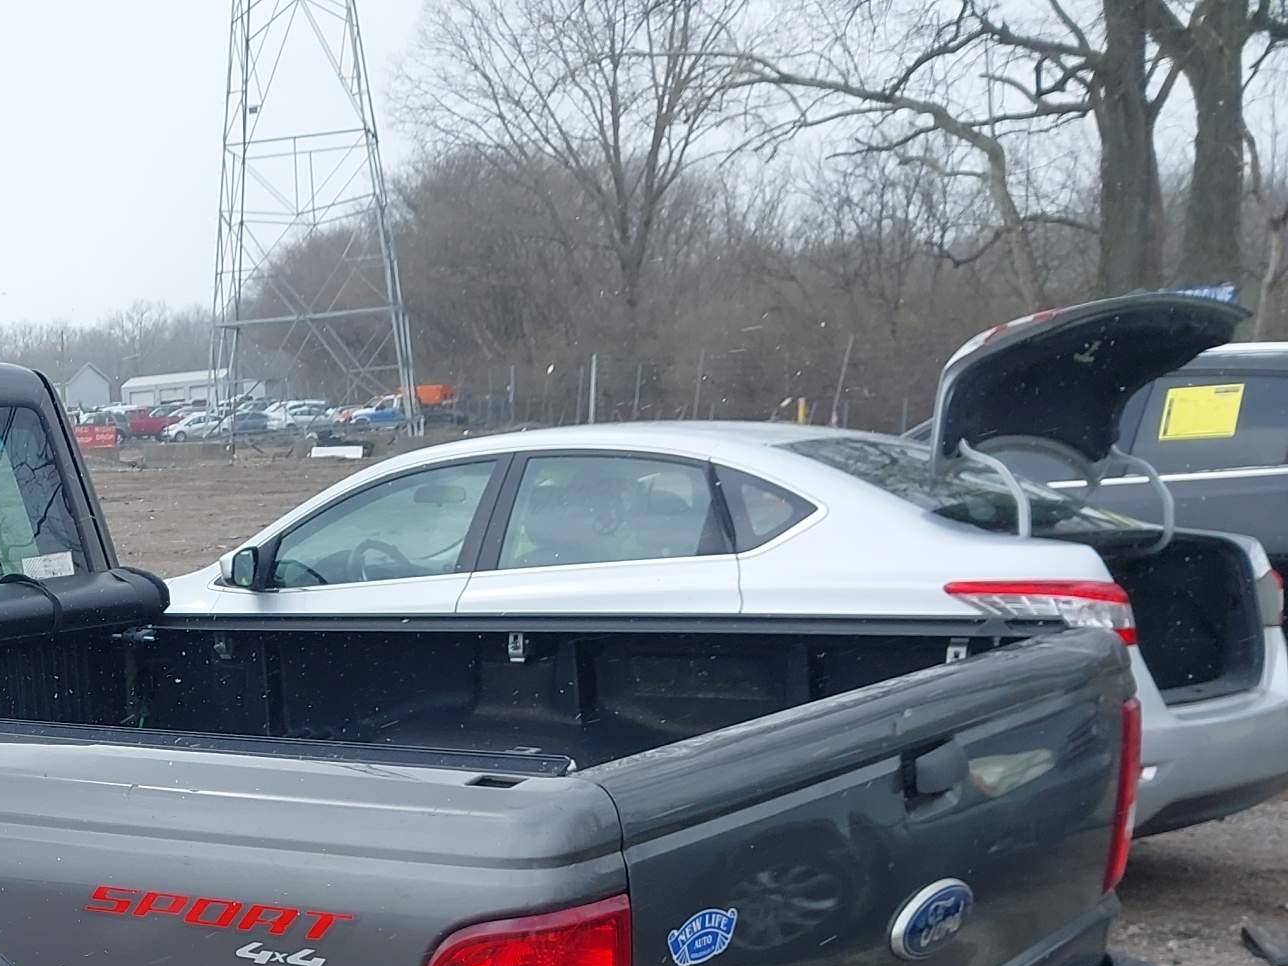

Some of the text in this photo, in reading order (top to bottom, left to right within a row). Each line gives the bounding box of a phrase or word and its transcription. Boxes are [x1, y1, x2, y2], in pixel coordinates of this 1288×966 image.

[85, 884, 354, 941] SPORT
[677, 913, 729, 948] NEW LIFE
[694, 934, 713, 950] AUTO
